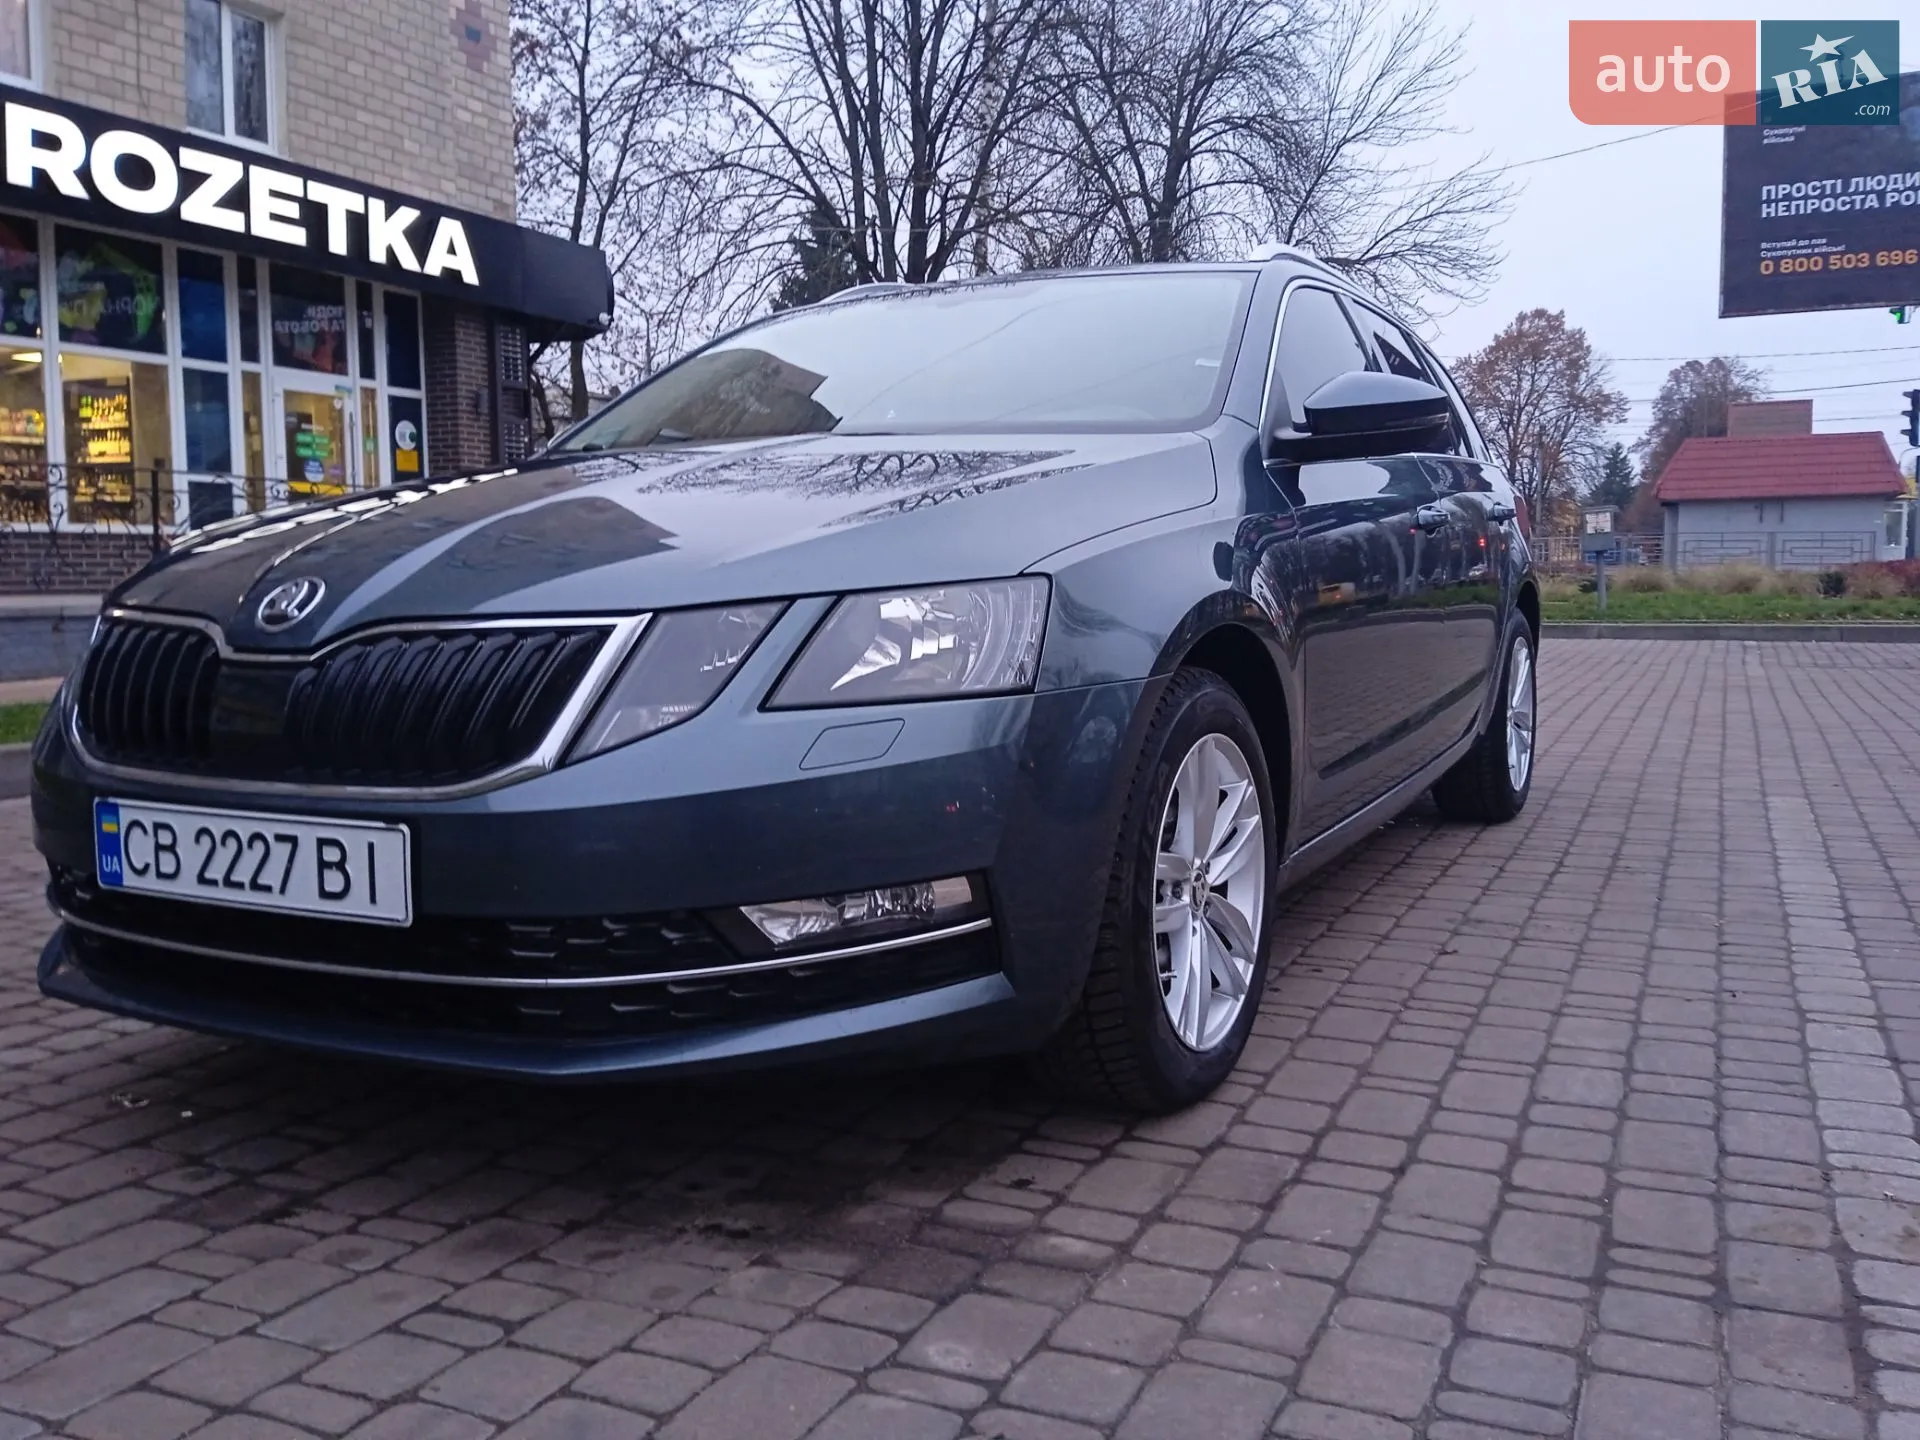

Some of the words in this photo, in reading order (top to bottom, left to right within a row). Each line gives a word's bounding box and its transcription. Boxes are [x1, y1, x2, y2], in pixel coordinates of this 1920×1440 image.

[4, 101, 480, 287] ROZETKA
[1761, 178, 1842, 201] ПРОСТІ
[1761, 193, 1880, 218] НЕПРОСТА
[1760, 259, 1774, 275] 0
[1779, 256, 1823, 274] 800
[1828, 252, 1870, 270] 503
[1875, 248, 1919, 267] 696
[102, 858, 121, 876] UA
[123, 818, 183, 881] CB
[194, 826, 299, 896] 2227
[316, 836, 378, 906] BI
